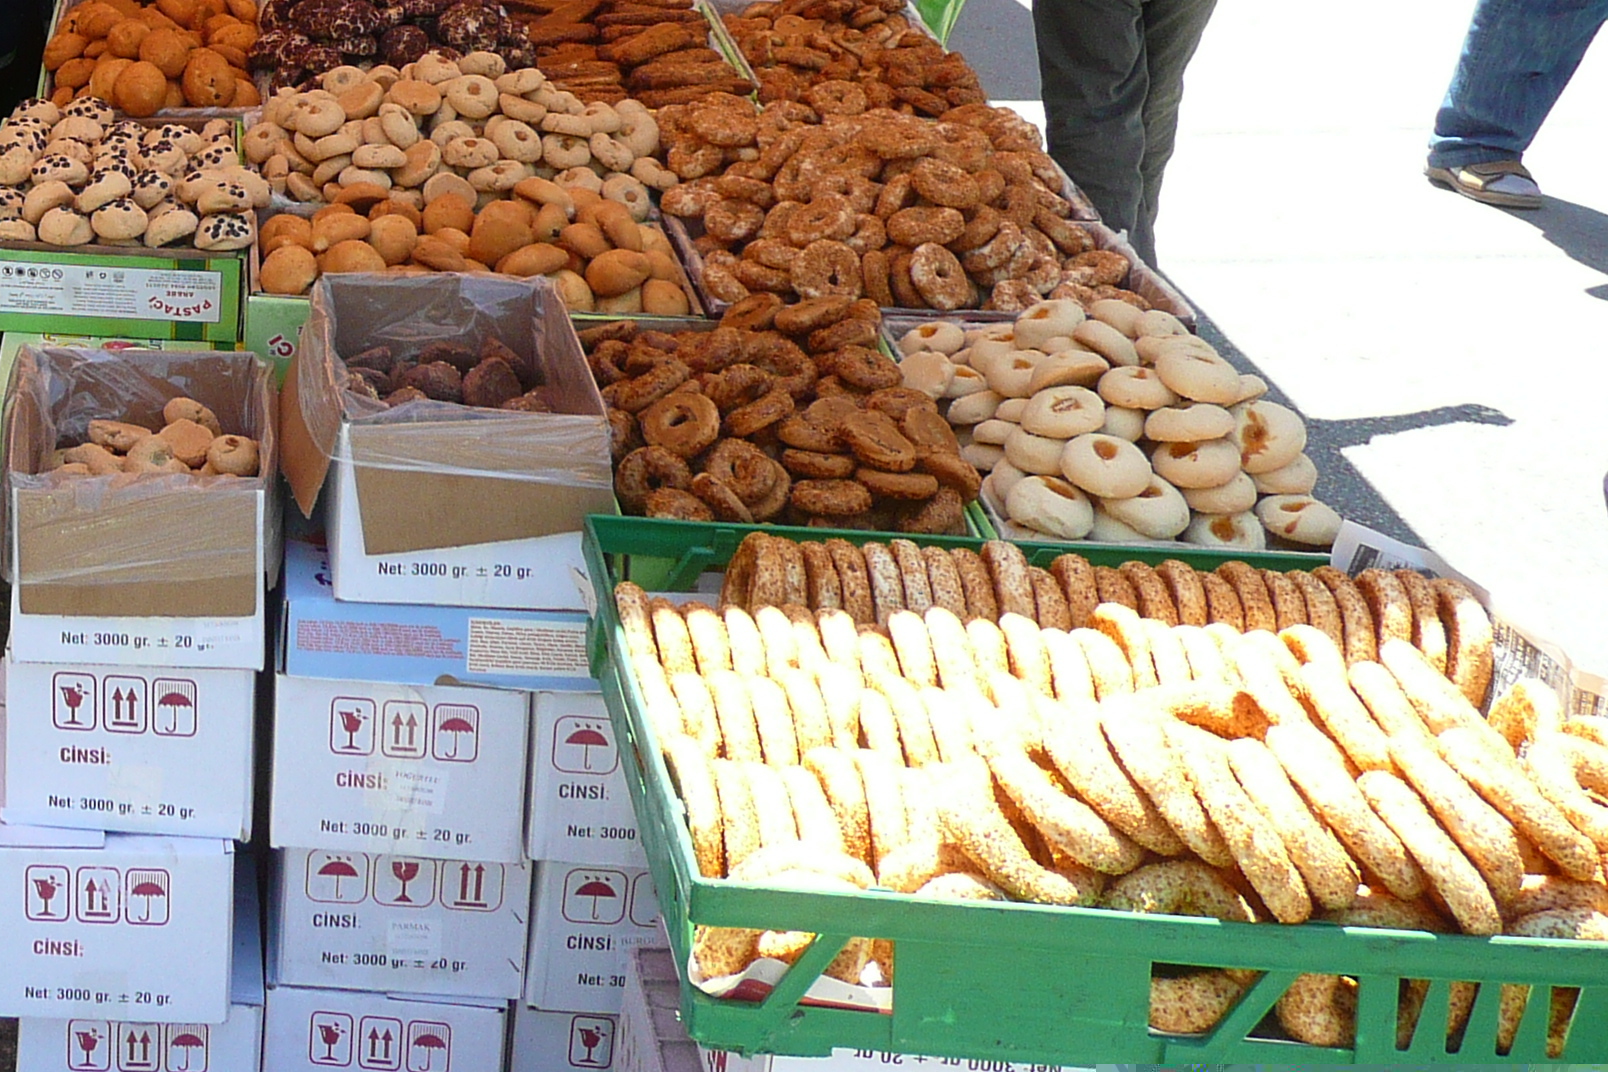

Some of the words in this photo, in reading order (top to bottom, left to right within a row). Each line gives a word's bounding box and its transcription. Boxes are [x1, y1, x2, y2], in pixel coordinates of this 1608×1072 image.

[378, 561, 407, 576] Net:
[412, 563, 447, 577] 3000
[452, 566, 469, 579] gr.
[494, 564, 512, 578] 20
[517, 566, 534, 579] gr.
[61, 631, 89, 645] Net:
[94, 632, 129, 646] 3000
[134, 636, 150, 649] gr.
[175, 635, 192, 648] 20
[60, 745, 111, 765] CİNSİ:
[336, 771, 388, 791] CİNSİ:
[559, 781, 609, 801] CİNSİ:
[49, 795, 75, 809] Net:
[80, 798, 114, 812] 3000
[118, 802, 135, 815] gr.
[158, 803, 175, 816] 20
[180, 807, 195, 819] gr.
[321, 820, 348, 834] Net:
[353, 822, 388, 837] 3000
[393, 826, 408, 840] gr.
[434, 828, 451, 842] 20
[456, 831, 472, 844] gr.
[600, 826, 636, 841] 3000
[313, 912, 362, 929] CİNSİ:
[33, 938, 84, 957] CİNSİ:
[567, 932, 616, 950] CİNSİ:
[321, 951, 348, 965] Net:
[353, 953, 387, 967] 3000
[452, 959, 469, 972] gr.
[609, 975, 626, 988] 30
[25, 986, 51, 1000] Net:
[57, 988, 90, 1001] 3000
[96, 991, 111, 1003] gr.
[135, 991, 152, 1004] 20
[157, 994, 172, 1006] gr.
